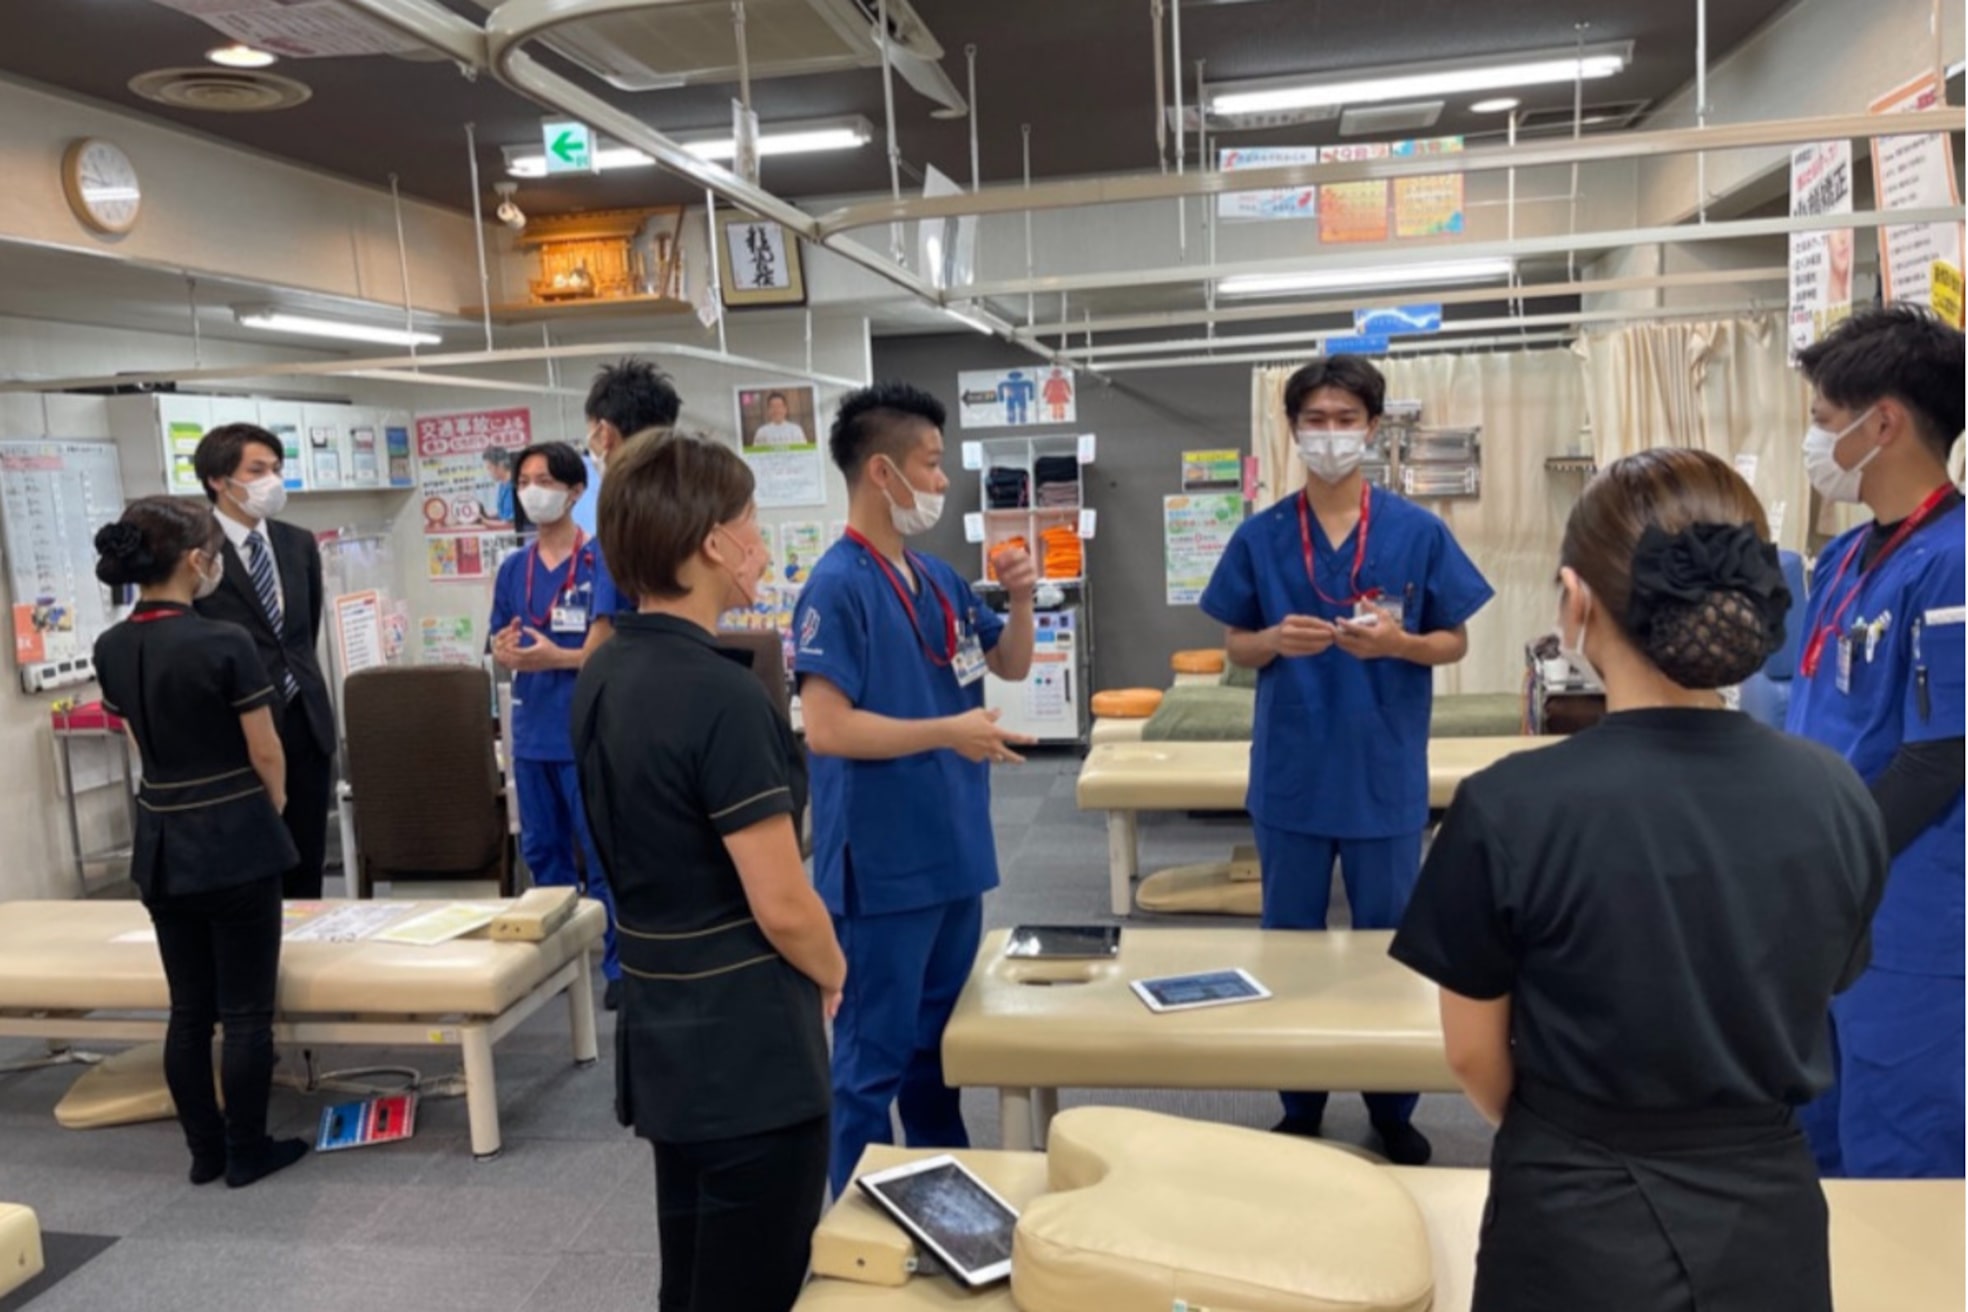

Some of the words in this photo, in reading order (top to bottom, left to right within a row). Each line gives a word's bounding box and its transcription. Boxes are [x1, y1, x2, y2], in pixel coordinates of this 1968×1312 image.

[421, 415, 525, 438] 交通事故による
